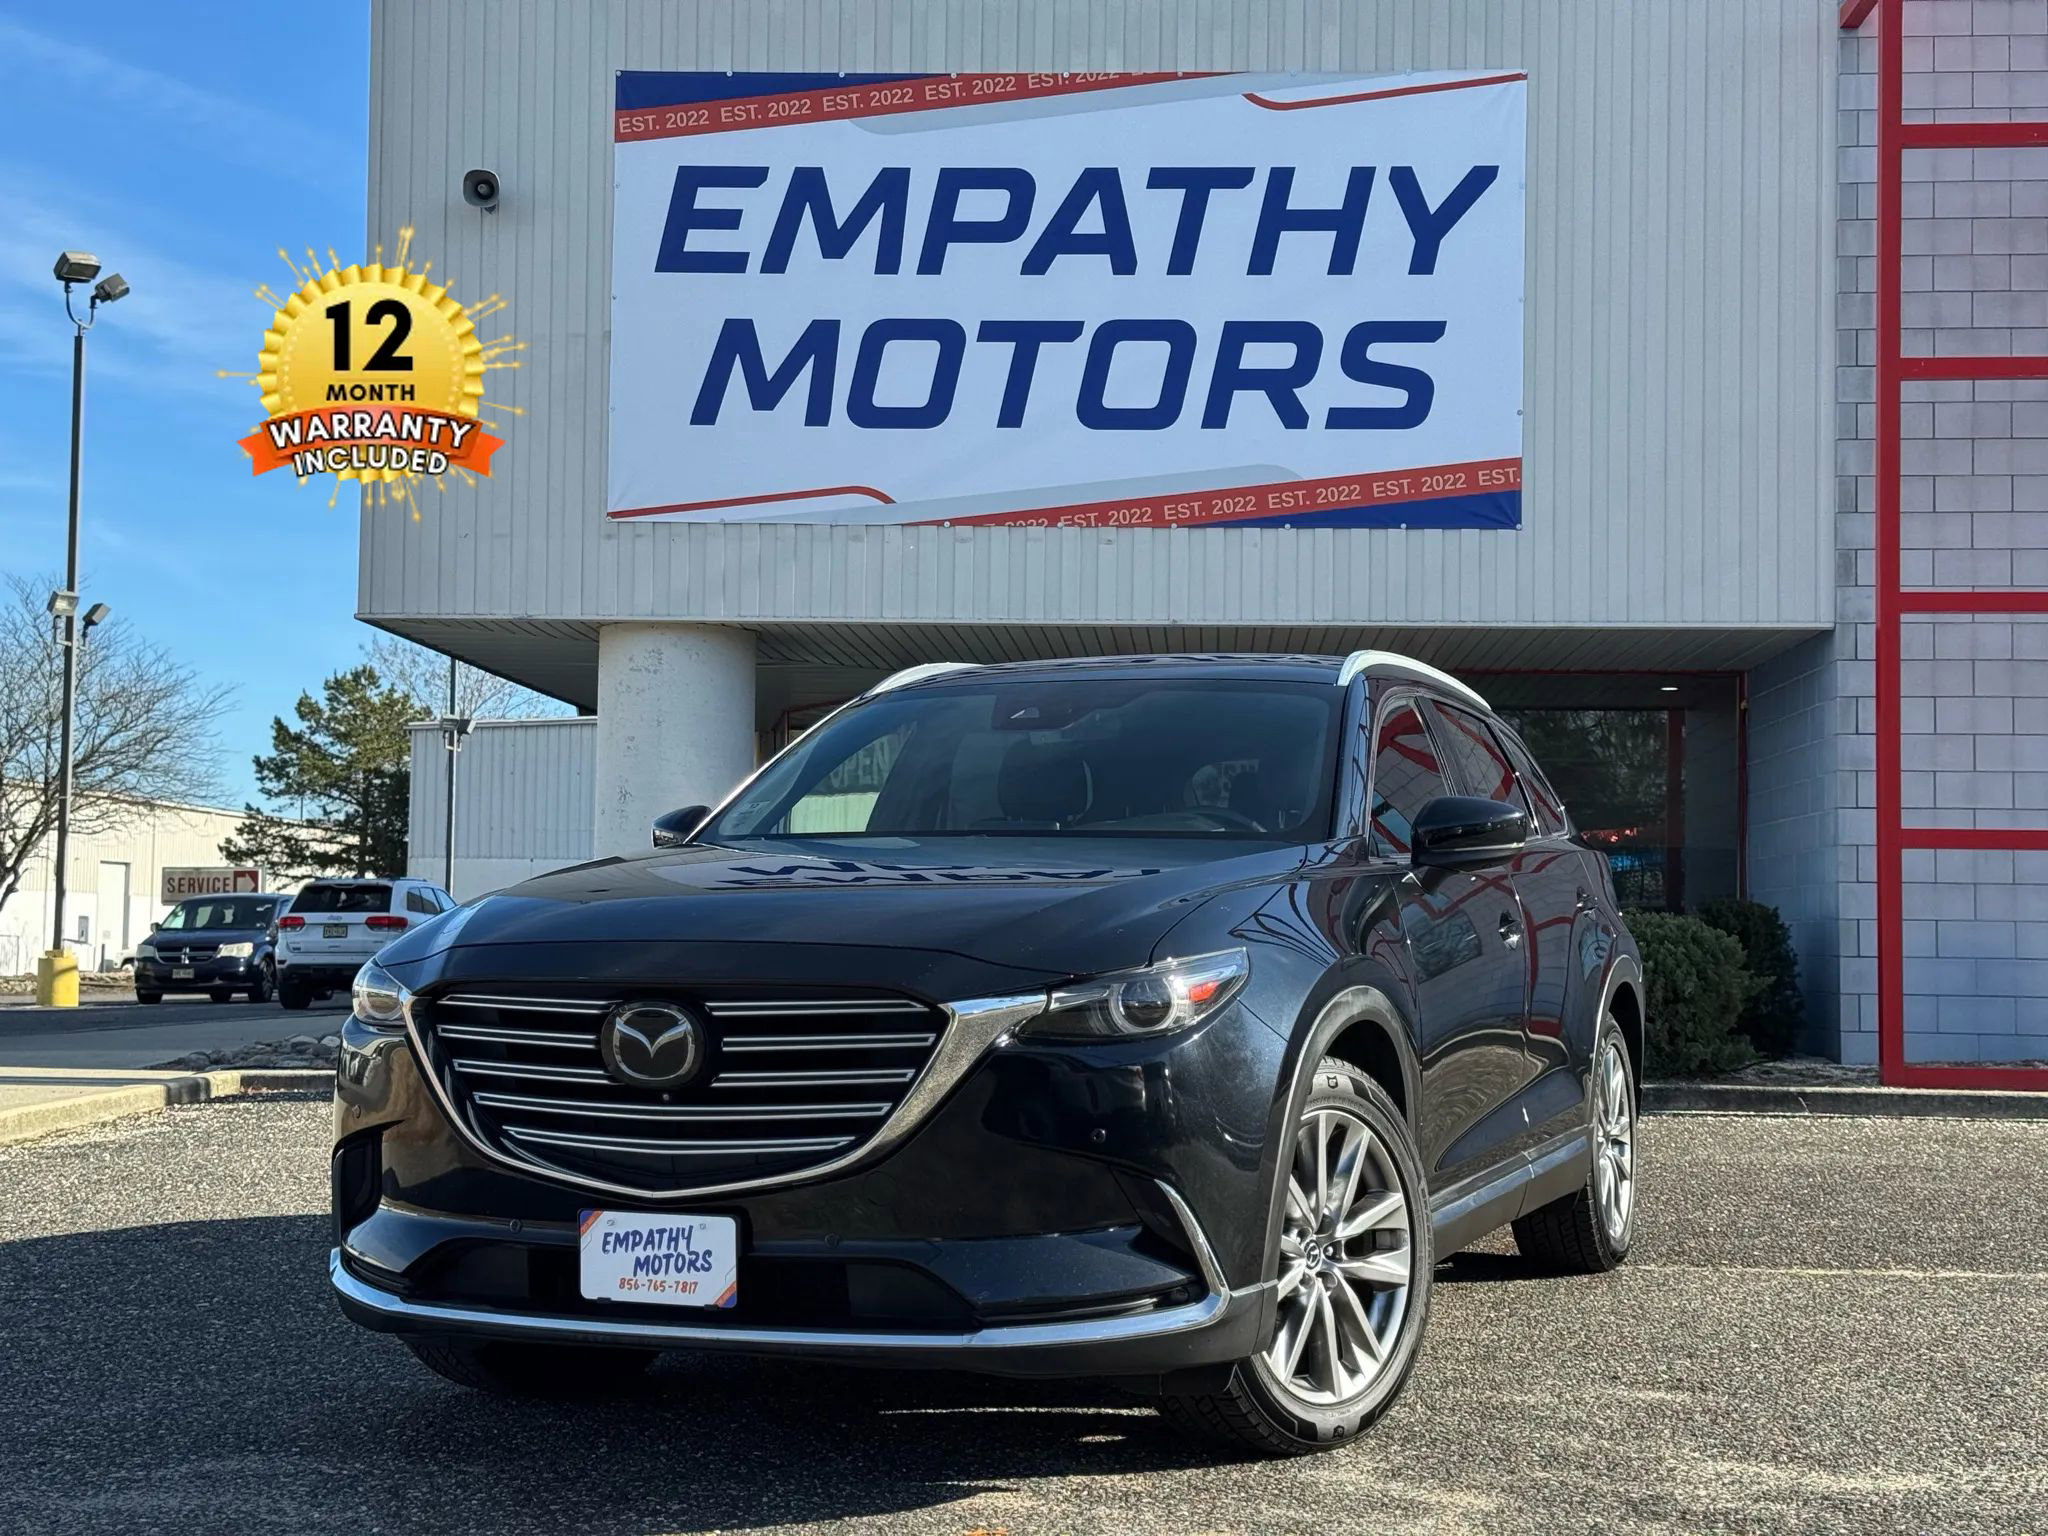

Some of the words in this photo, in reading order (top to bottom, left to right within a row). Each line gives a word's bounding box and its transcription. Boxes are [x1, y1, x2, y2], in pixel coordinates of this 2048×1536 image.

[619, 115, 660, 133] EST.
[666, 109, 709, 128] 2022
[721, 104, 761, 122] EST.
[768, 99, 811, 118] 2022
[823, 93, 863, 112] EST.
[870, 88, 914, 107] 2022
[925, 82, 966, 100] EST.
[972, 76, 1016, 95] 2022
[654, 165, 1500, 276] EMPATHY
[689, 318, 1448, 431] MOTORS
[1108, 507, 1152, 526] 2022
[1164, 501, 1205, 520] EST.
[1212, 496, 1257, 515] 2022
[1268, 490, 1310, 509] EST.
[1316, 485, 1361, 504] 2022
[1373, 479, 1415, 498] EST.
[1422, 473, 1467, 492] 2022
[1478, 467, 1520, 486] EST.
[167, 876, 232, 893] SERVICE
[602, 1225, 693, 1254] EMPATHY
[633, 1249, 713, 1277] MOTORS
[619, 1277, 699, 1294] 856-765-7817
